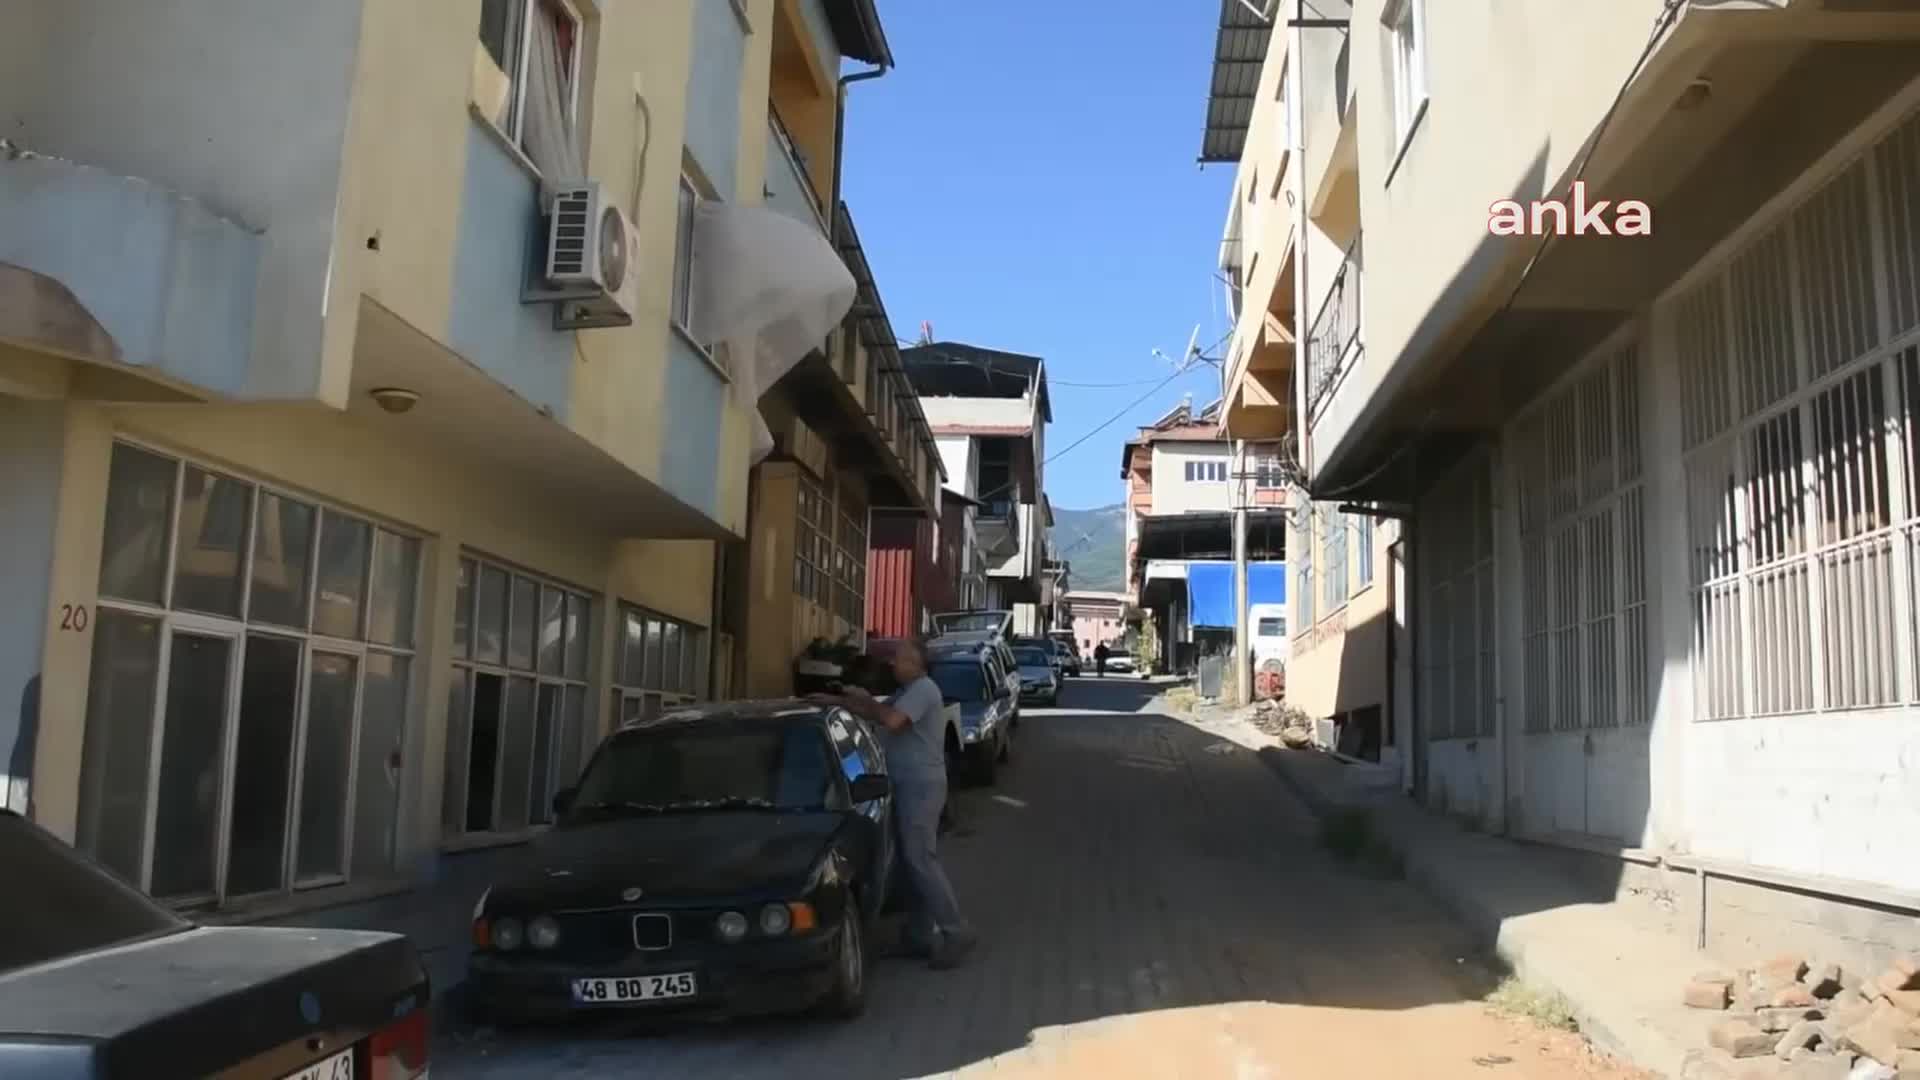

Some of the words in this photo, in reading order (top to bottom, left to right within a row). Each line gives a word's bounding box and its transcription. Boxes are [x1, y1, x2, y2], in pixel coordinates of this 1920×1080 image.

[61, 604, 88, 632] 20
[582, 981, 607, 999] 48
[652, 975, 692, 996] 245
